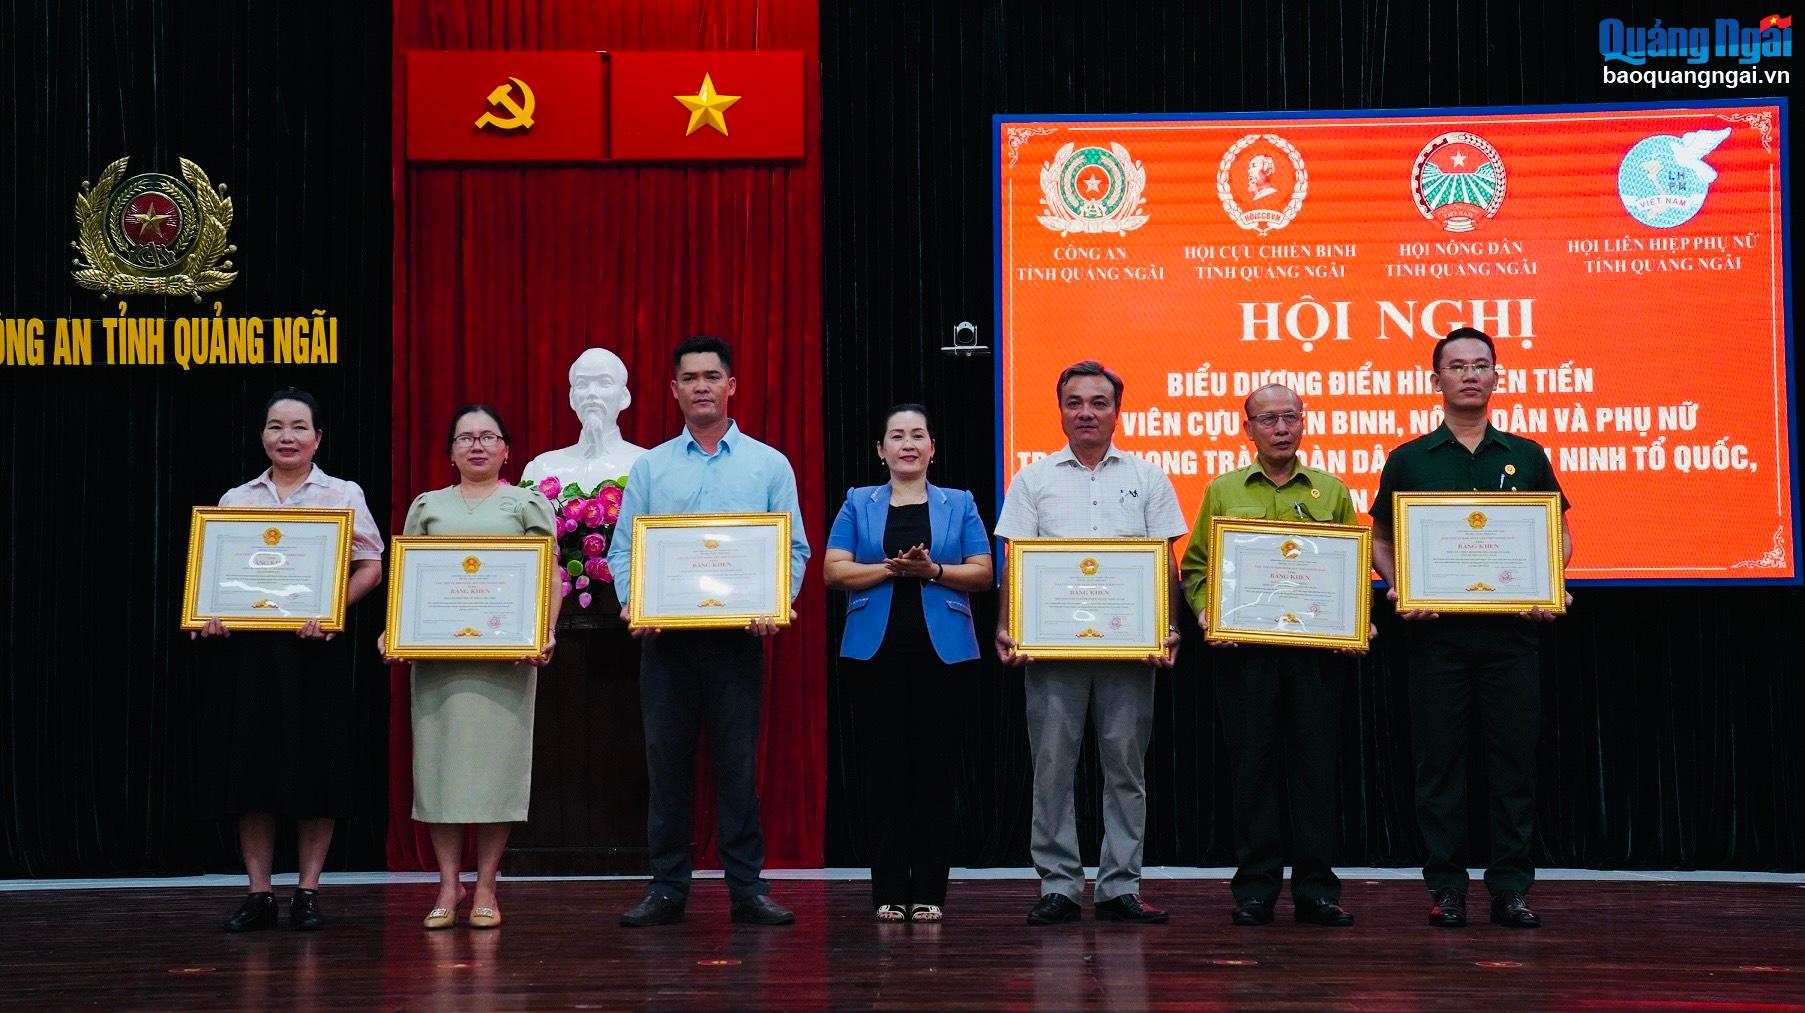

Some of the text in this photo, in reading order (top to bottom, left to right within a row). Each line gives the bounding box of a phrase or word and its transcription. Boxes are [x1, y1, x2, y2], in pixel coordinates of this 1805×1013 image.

[1053, 244, 1127, 260] CÔNG AN
[1184, 244, 1214, 262] HỘI
[1259, 241, 1311, 259] CHIẾN
[1316, 244, 1356, 258] BINH
[1400, 238, 1523, 260] HỘI NÔNG DÂN
[1568, 232, 1760, 256] HỘI LIÊN HIỆP PHỤ NỮ
[1123, 263, 1164, 281] NGÃI
[1304, 262, 1345, 278] NGÃI
[1495, 258, 1537, 276] NGÃI
[1698, 254, 1741, 271] NGÃI
[1238, 295, 1536, 352] HỘI NGHỊ
[53, 318, 92, 366] AN
[102, 301, 164, 365] TỈNH
[174, 301, 264, 371] QUẢNG
[273, 308, 337, 364] NGÃI
[1167, 362, 1226, 397] BIỂU
[1328, 360, 1390, 395] ĐIỂN
[1533, 360, 1593, 393] TIẾN
[1121, 406, 1181, 437] VIÊN
[1187, 410, 1239, 441] CỰU
[1332, 410, 1404, 437] BINH,
[1491, 404, 1548, 433] DÂN
[1554, 403, 1589, 432] VÀ
[1596, 406, 1651, 436] PHỤ
[1658, 401, 1699, 431] NỮ
[1203, 444, 1258, 475] TRÀ
[1559, 446, 1627, 472] NINH
[1632, 436, 1666, 471] TỔ
[1673, 436, 1758, 473] QUỐC,
